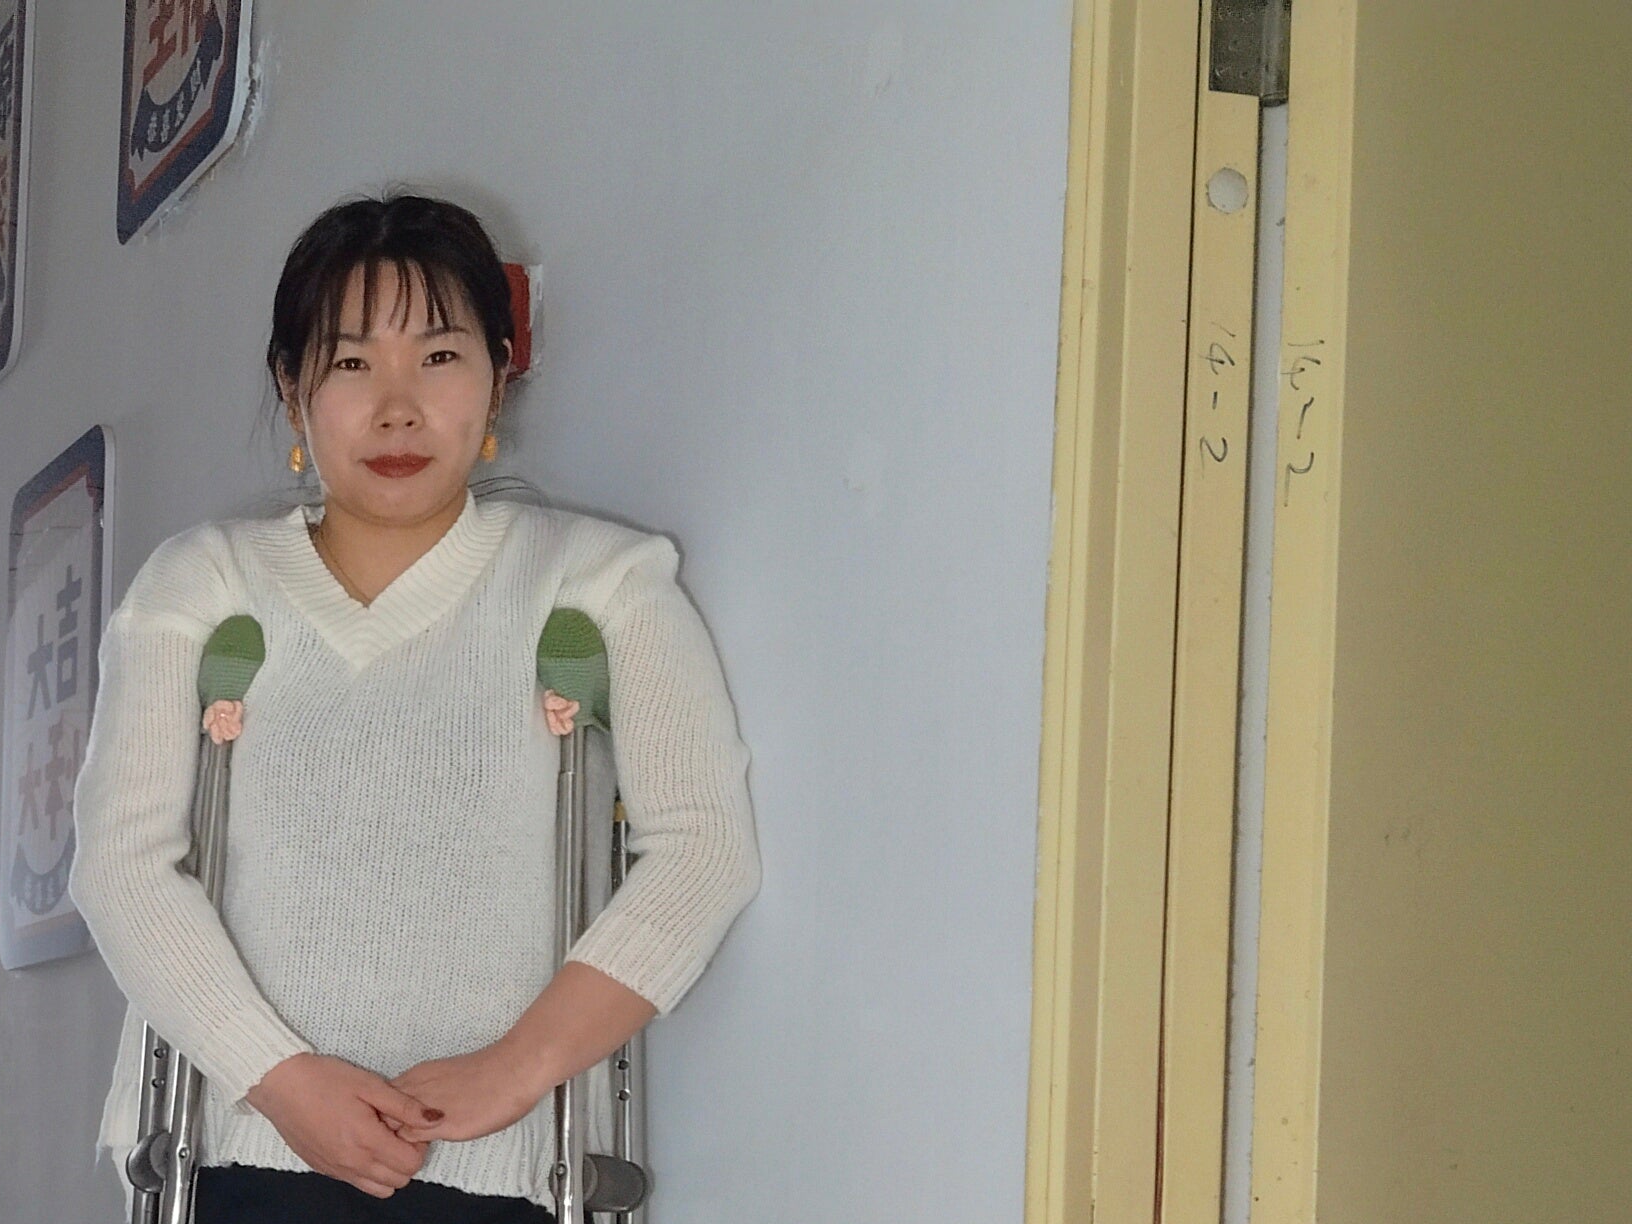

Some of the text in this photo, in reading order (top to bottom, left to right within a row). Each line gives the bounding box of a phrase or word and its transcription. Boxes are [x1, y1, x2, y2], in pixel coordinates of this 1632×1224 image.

[1199, 322, 1237, 481] 14-2
[27, 564, 83, 720] 大吉
[18, 711, 80, 841] 大利
